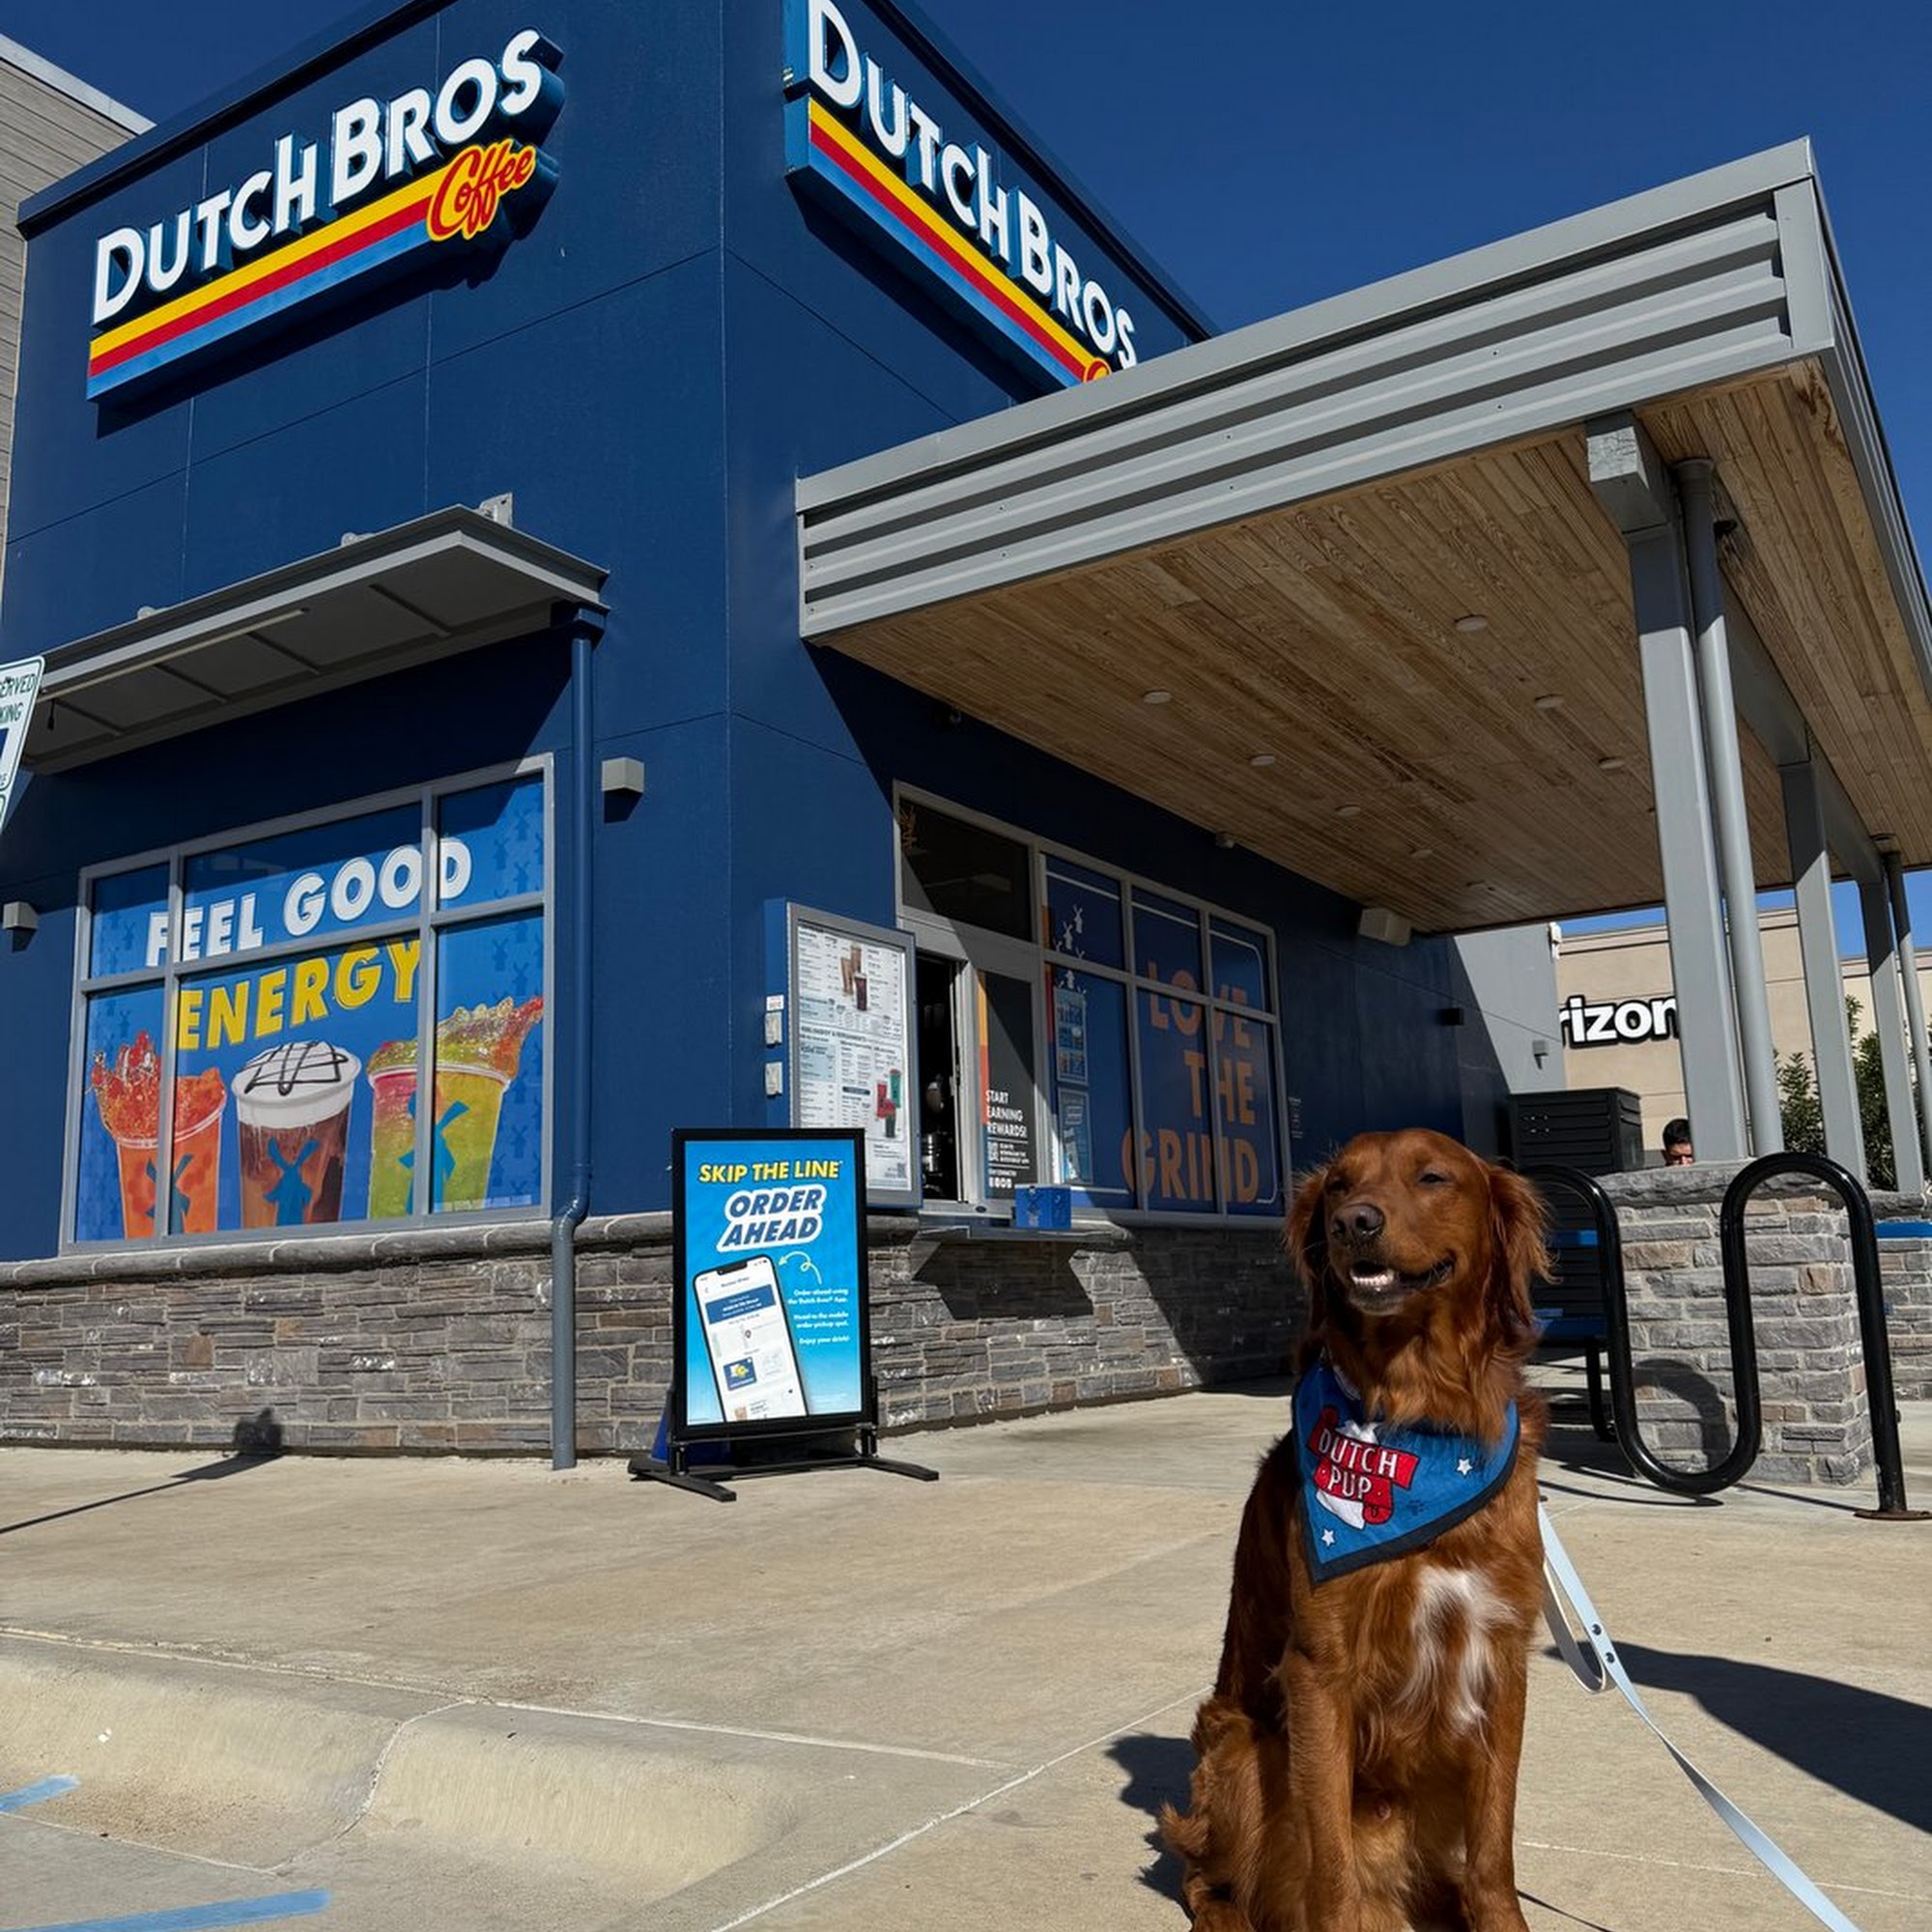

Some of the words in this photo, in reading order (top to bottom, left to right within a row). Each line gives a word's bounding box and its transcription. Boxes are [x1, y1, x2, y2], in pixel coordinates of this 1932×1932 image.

[93, 134, 317, 325] DUTCH
[331, 30, 543, 206] BROS
[431, 145, 534, 238] Coffee
[810, 0, 1009, 259] DUTCH
[1019, 191, 1137, 369] BROS
[146, 892, 264, 966] FEEL
[283, 837, 471, 936] GOOD
[178, 939, 421, 1050] ENERGY
[985, 1090, 1009, 1104] START
[1183, 1050, 1255, 1124] THE
[986, 1105, 1023, 1122] EARNING
[699, 1163, 748, 1183] SKIP
[753, 1161, 789, 1179] THE
[729, 1189, 823, 1218] ORDER
[723, 1217, 819, 1247] AHEAD
[1318, 1428, 1398, 1478] DUTCH
[1327, 1465, 1372, 1499] PUP
